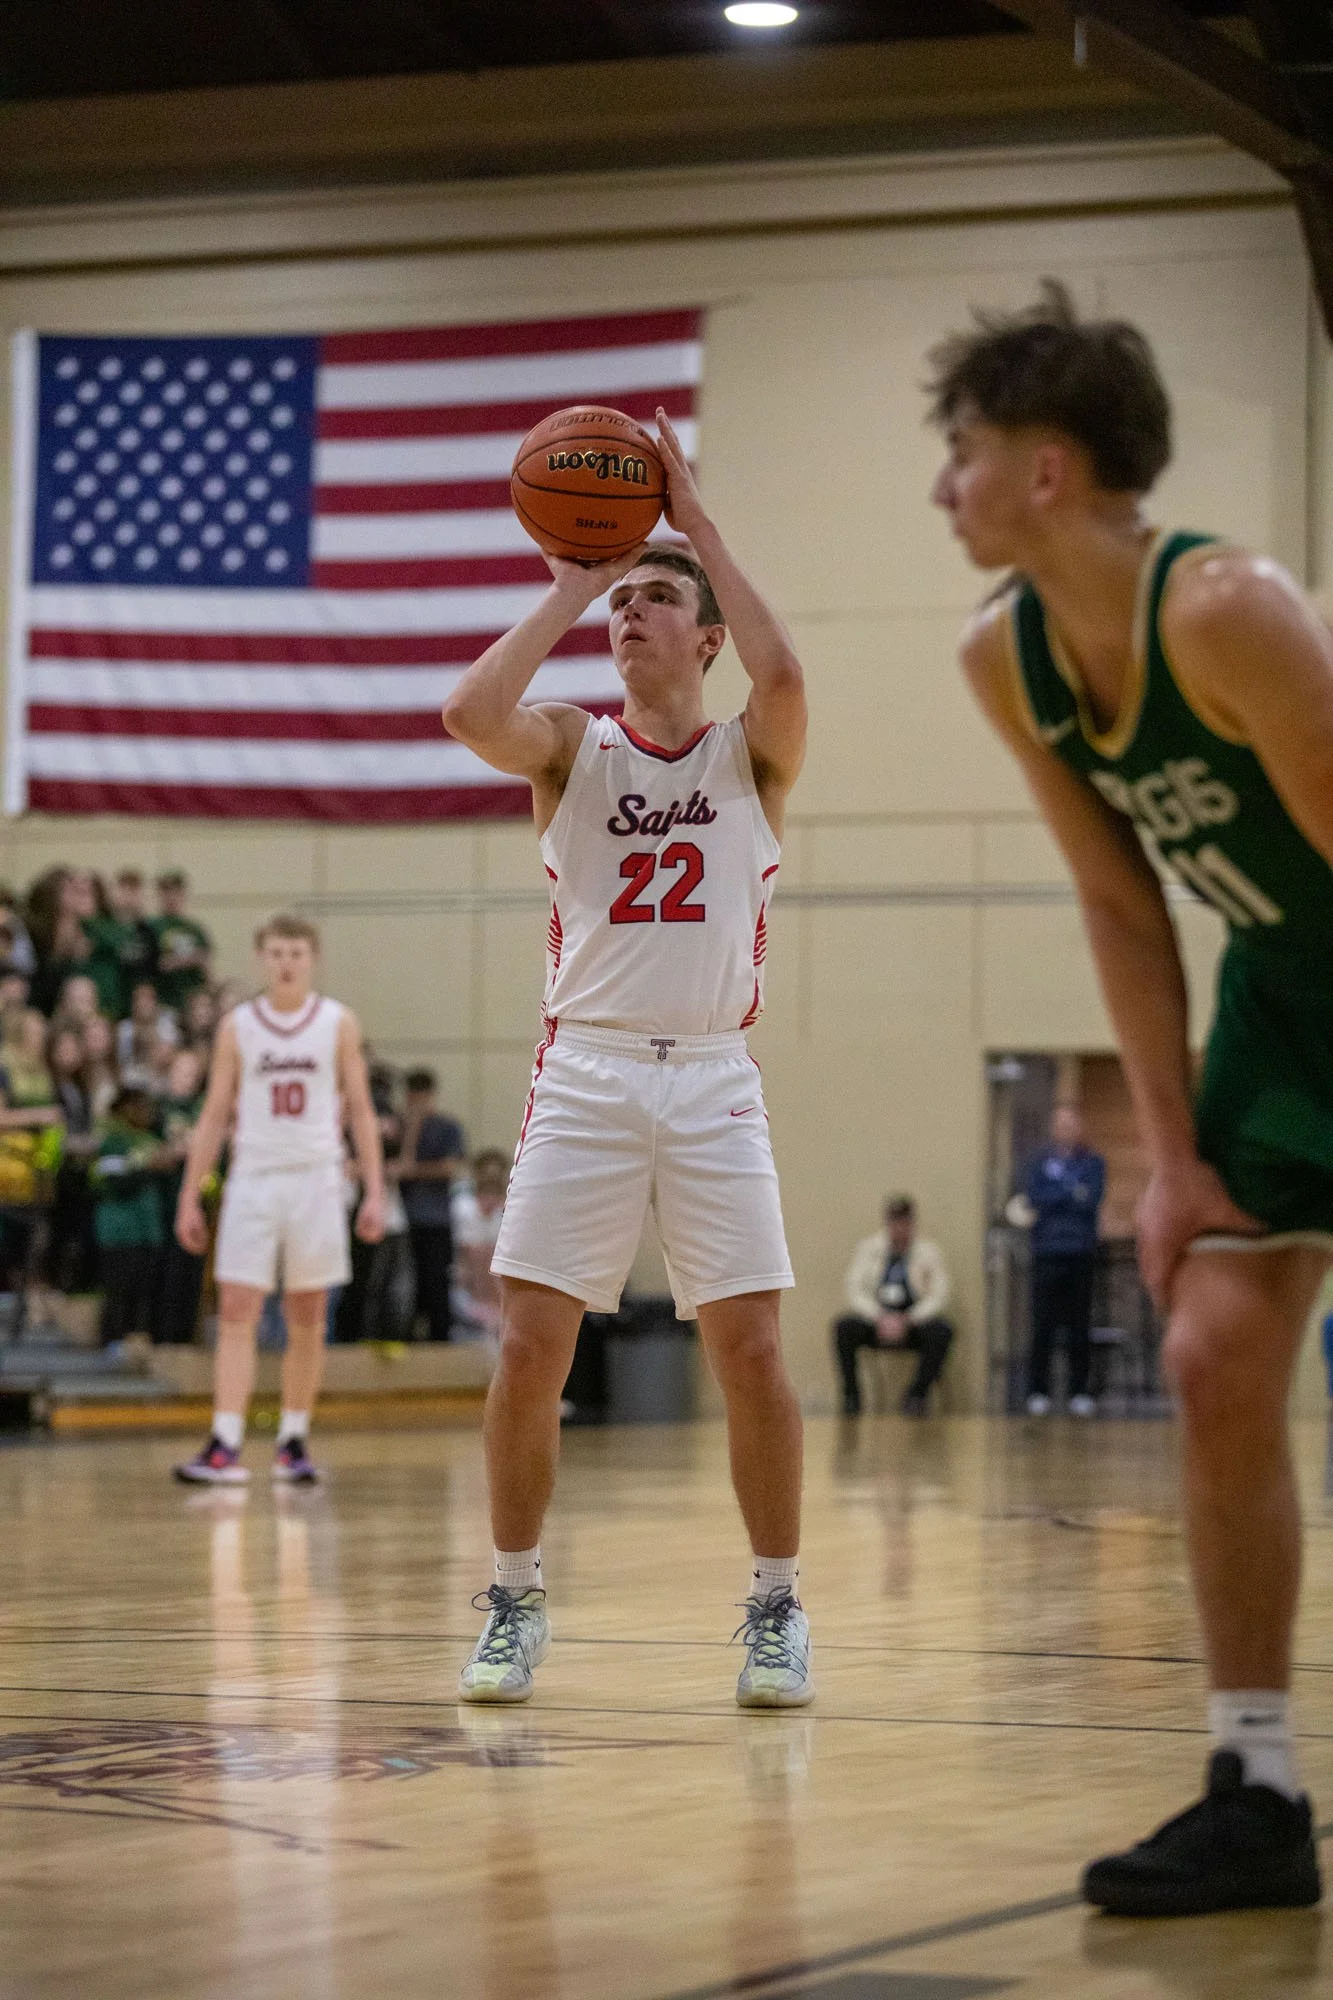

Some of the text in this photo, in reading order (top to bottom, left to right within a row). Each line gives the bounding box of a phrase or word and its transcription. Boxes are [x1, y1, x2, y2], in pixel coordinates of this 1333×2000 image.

[549, 412, 637, 434] OLUTION
[547, 451, 649, 486] Wilson
[1090, 758, 1241, 842] GIS
[609, 842, 706, 925] 22
[270, 1081, 307, 1119] 10
